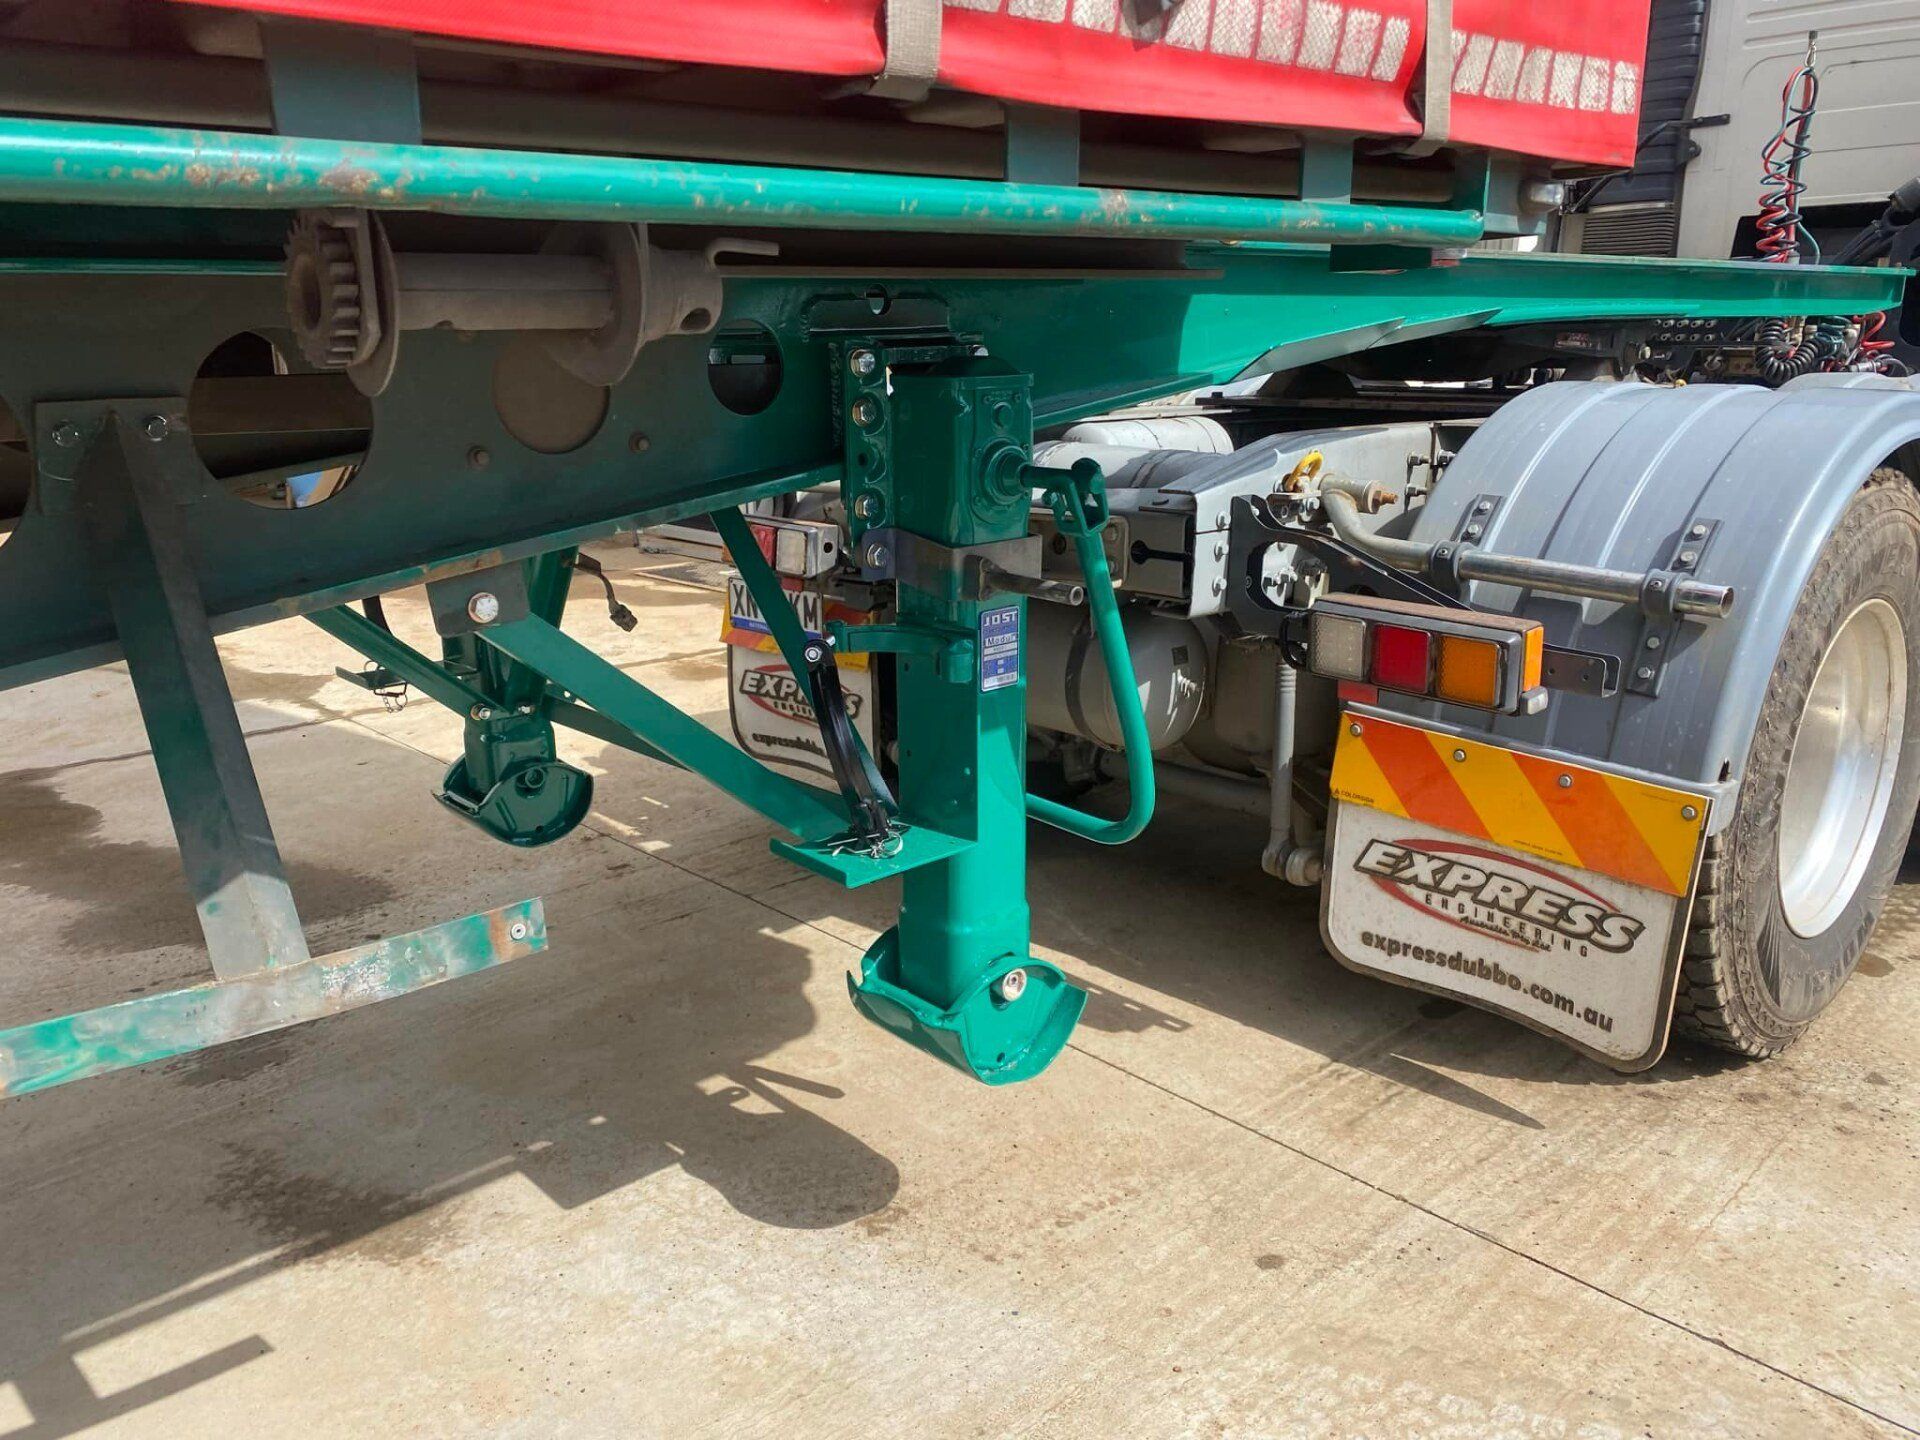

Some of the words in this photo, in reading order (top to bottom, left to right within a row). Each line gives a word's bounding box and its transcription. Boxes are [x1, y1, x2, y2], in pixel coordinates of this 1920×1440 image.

[984, 610, 1017, 626] JOST
[739, 669, 864, 718] EXPS
[1354, 839, 1646, 953] EXPRESS
[1425, 890, 1588, 957] ENGINEERING
[1361, 930, 1614, 1033] expressdubbo.com.au
